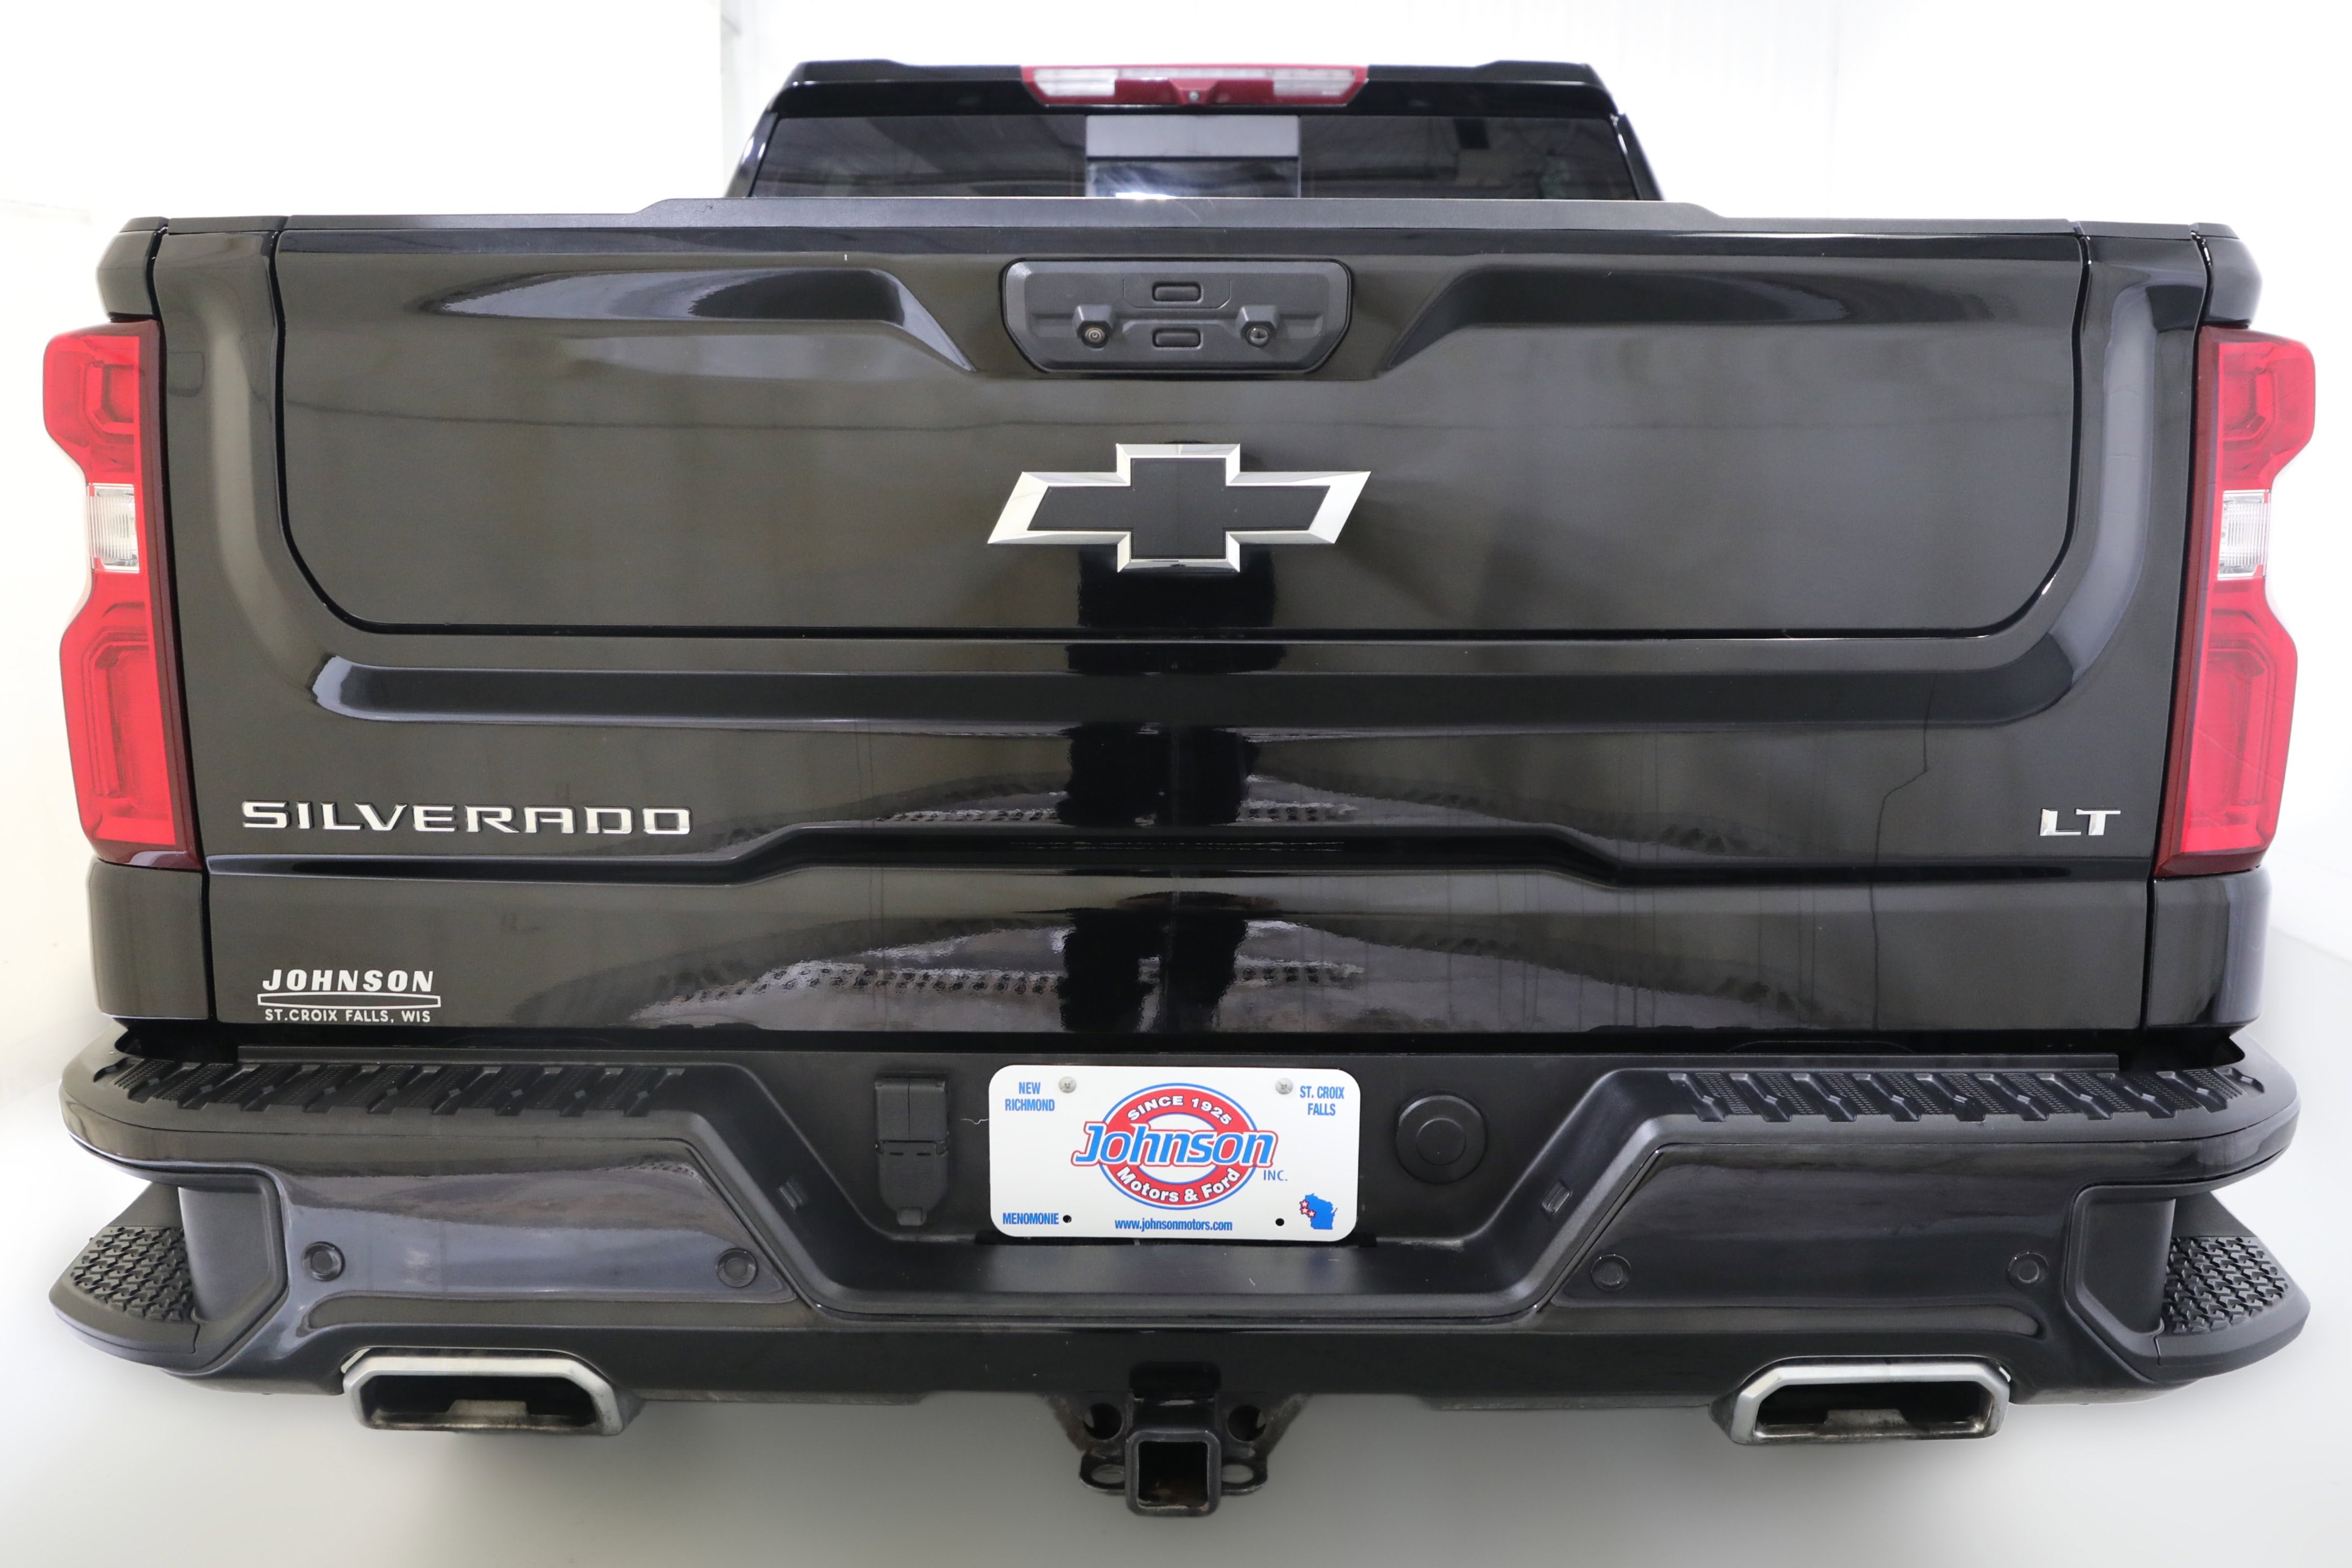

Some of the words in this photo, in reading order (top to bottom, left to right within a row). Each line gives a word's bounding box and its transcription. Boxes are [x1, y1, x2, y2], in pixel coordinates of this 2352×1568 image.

[241, 800, 692, 834] SILVERADO
[2040, 808, 2121, 836] LT
[262, 969, 434, 992] JOHNSON
[345, 1010, 394, 1023] FALLS,
[401, 1010, 430, 1022] WIS
[1019, 1082, 1041, 1094] NEW
[1300, 1086, 1314, 1098] ST.
[1317, 1086, 1345, 1099] CROIX
[1005, 1099, 1055, 1111] RICHMOND
[1127, 1095, 1184, 1121] SINCE
[1191, 1098, 1232, 1125] 1925
[1308, 1103, 1336, 1116] FALLS
[1073, 1123, 1276, 1166] Johnson
[1264, 1170, 1288, 1181] INC.
[1116, 1166, 1179, 1202] Motors
[1184, 1188, 1199, 1202] &
[1200, 1167, 1240, 1198] Ford
[1002, 1212, 1059, 1225] MENOMONIE
[1115, 1218, 1232, 1232] www.johnsonmotors.com
